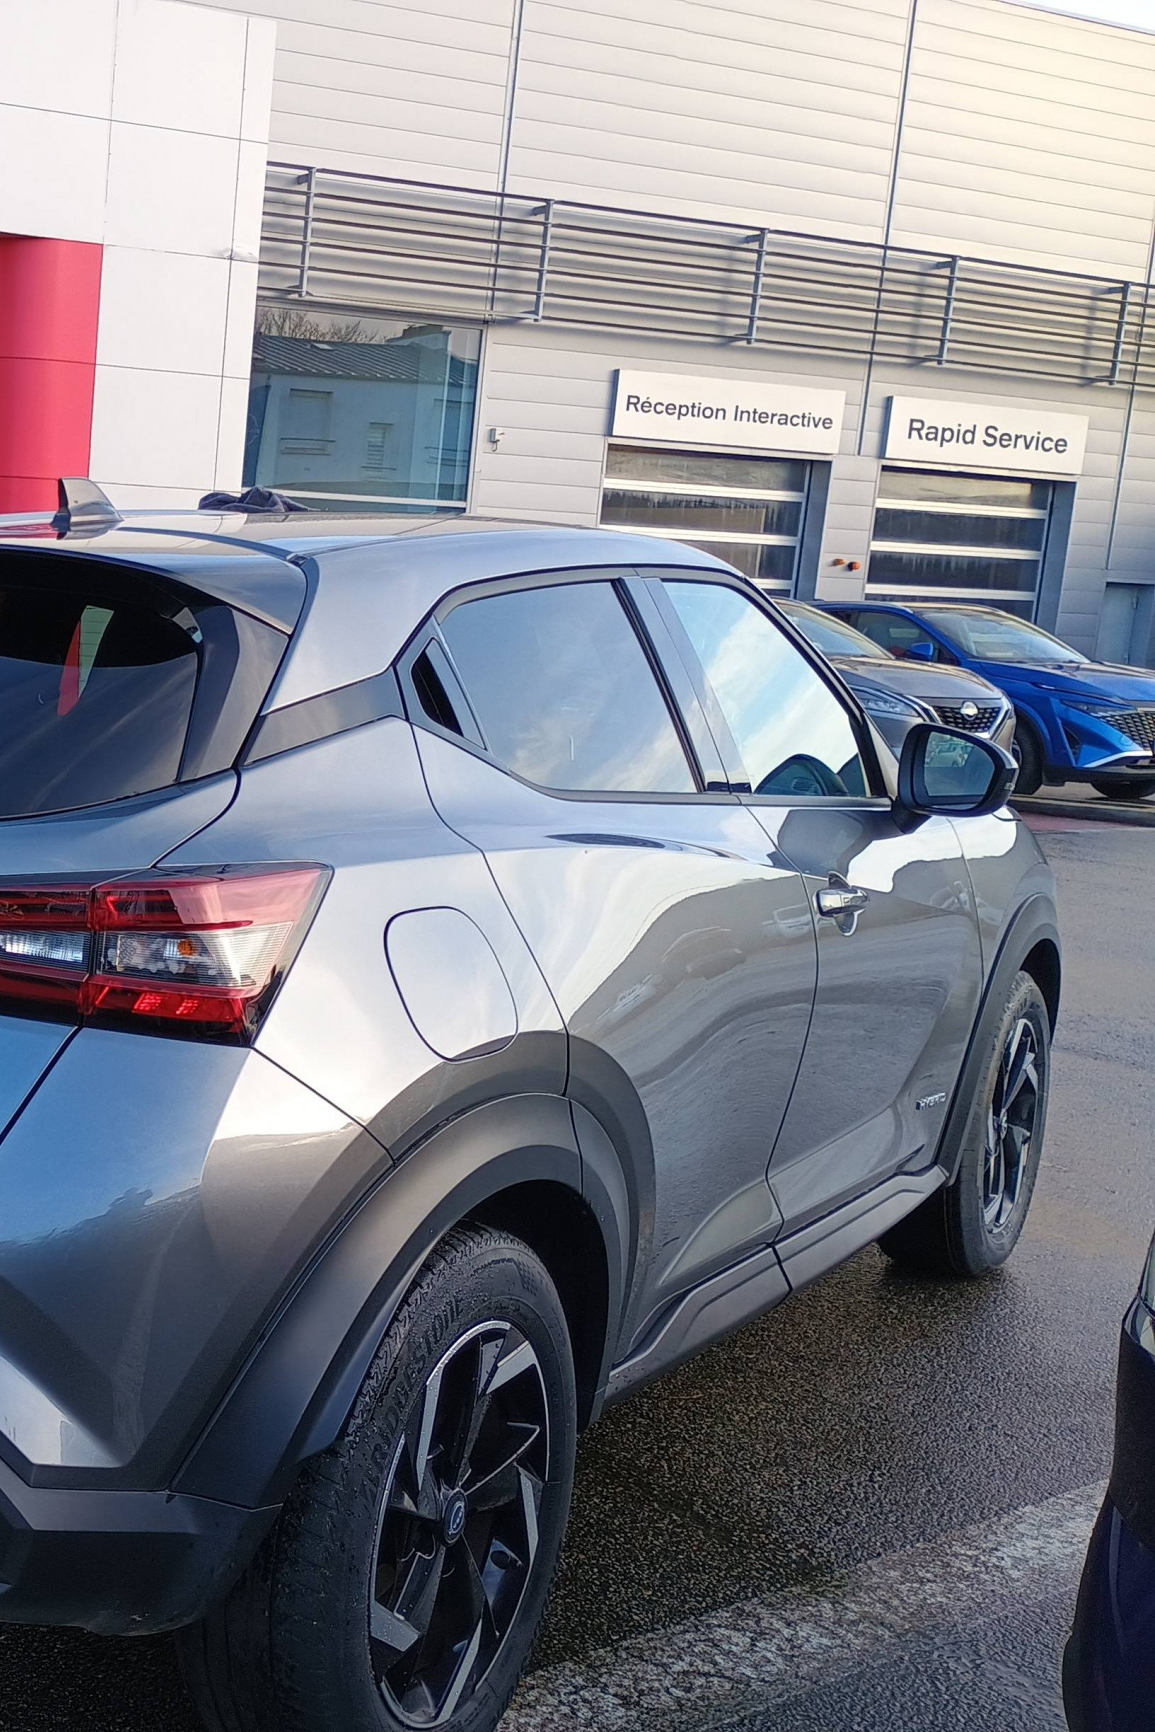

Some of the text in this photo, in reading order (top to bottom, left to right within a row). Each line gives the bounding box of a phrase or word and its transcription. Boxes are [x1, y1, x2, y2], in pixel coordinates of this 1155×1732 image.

[626, 394, 834, 430] Réception Interactive
[907, 418, 1068, 454] Rapid Service
